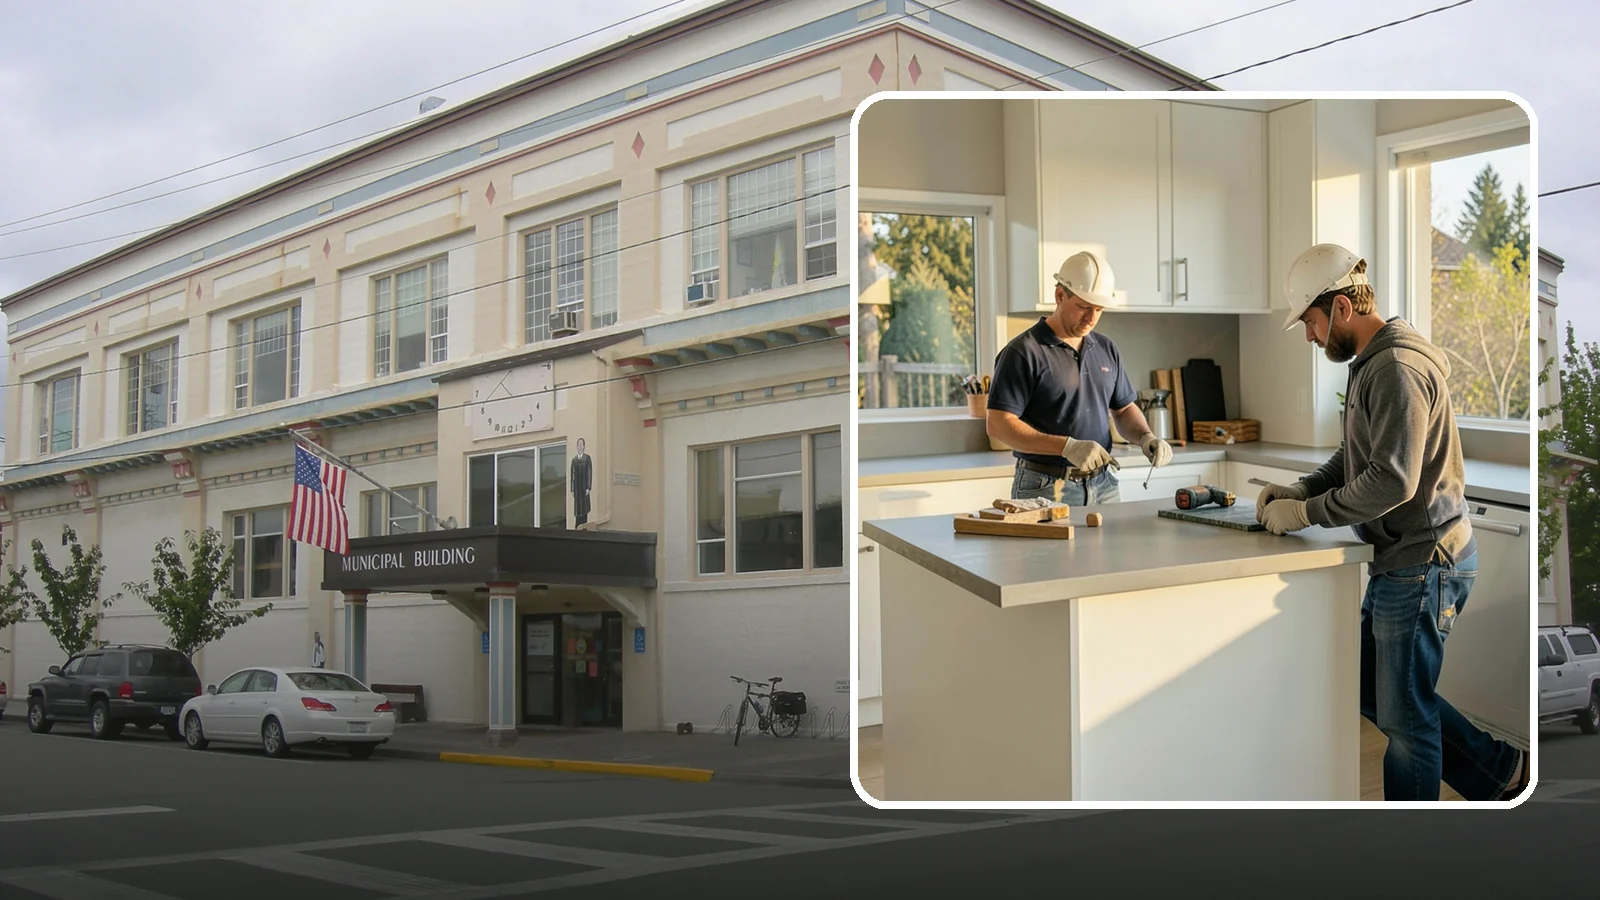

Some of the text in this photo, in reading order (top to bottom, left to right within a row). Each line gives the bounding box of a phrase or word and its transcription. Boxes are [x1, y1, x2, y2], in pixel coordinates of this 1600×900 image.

[475, 390, 479, 398] 7
[536, 402, 540, 410] 4
[481, 407, 485, 415] 8
[488, 417, 492, 425] 9
[529, 414, 533, 422] 3
[521, 420, 525, 428] 2
[507, 425, 513, 433] 12
[342, 546, 475, 572] MUNICIPAL BUILDING
